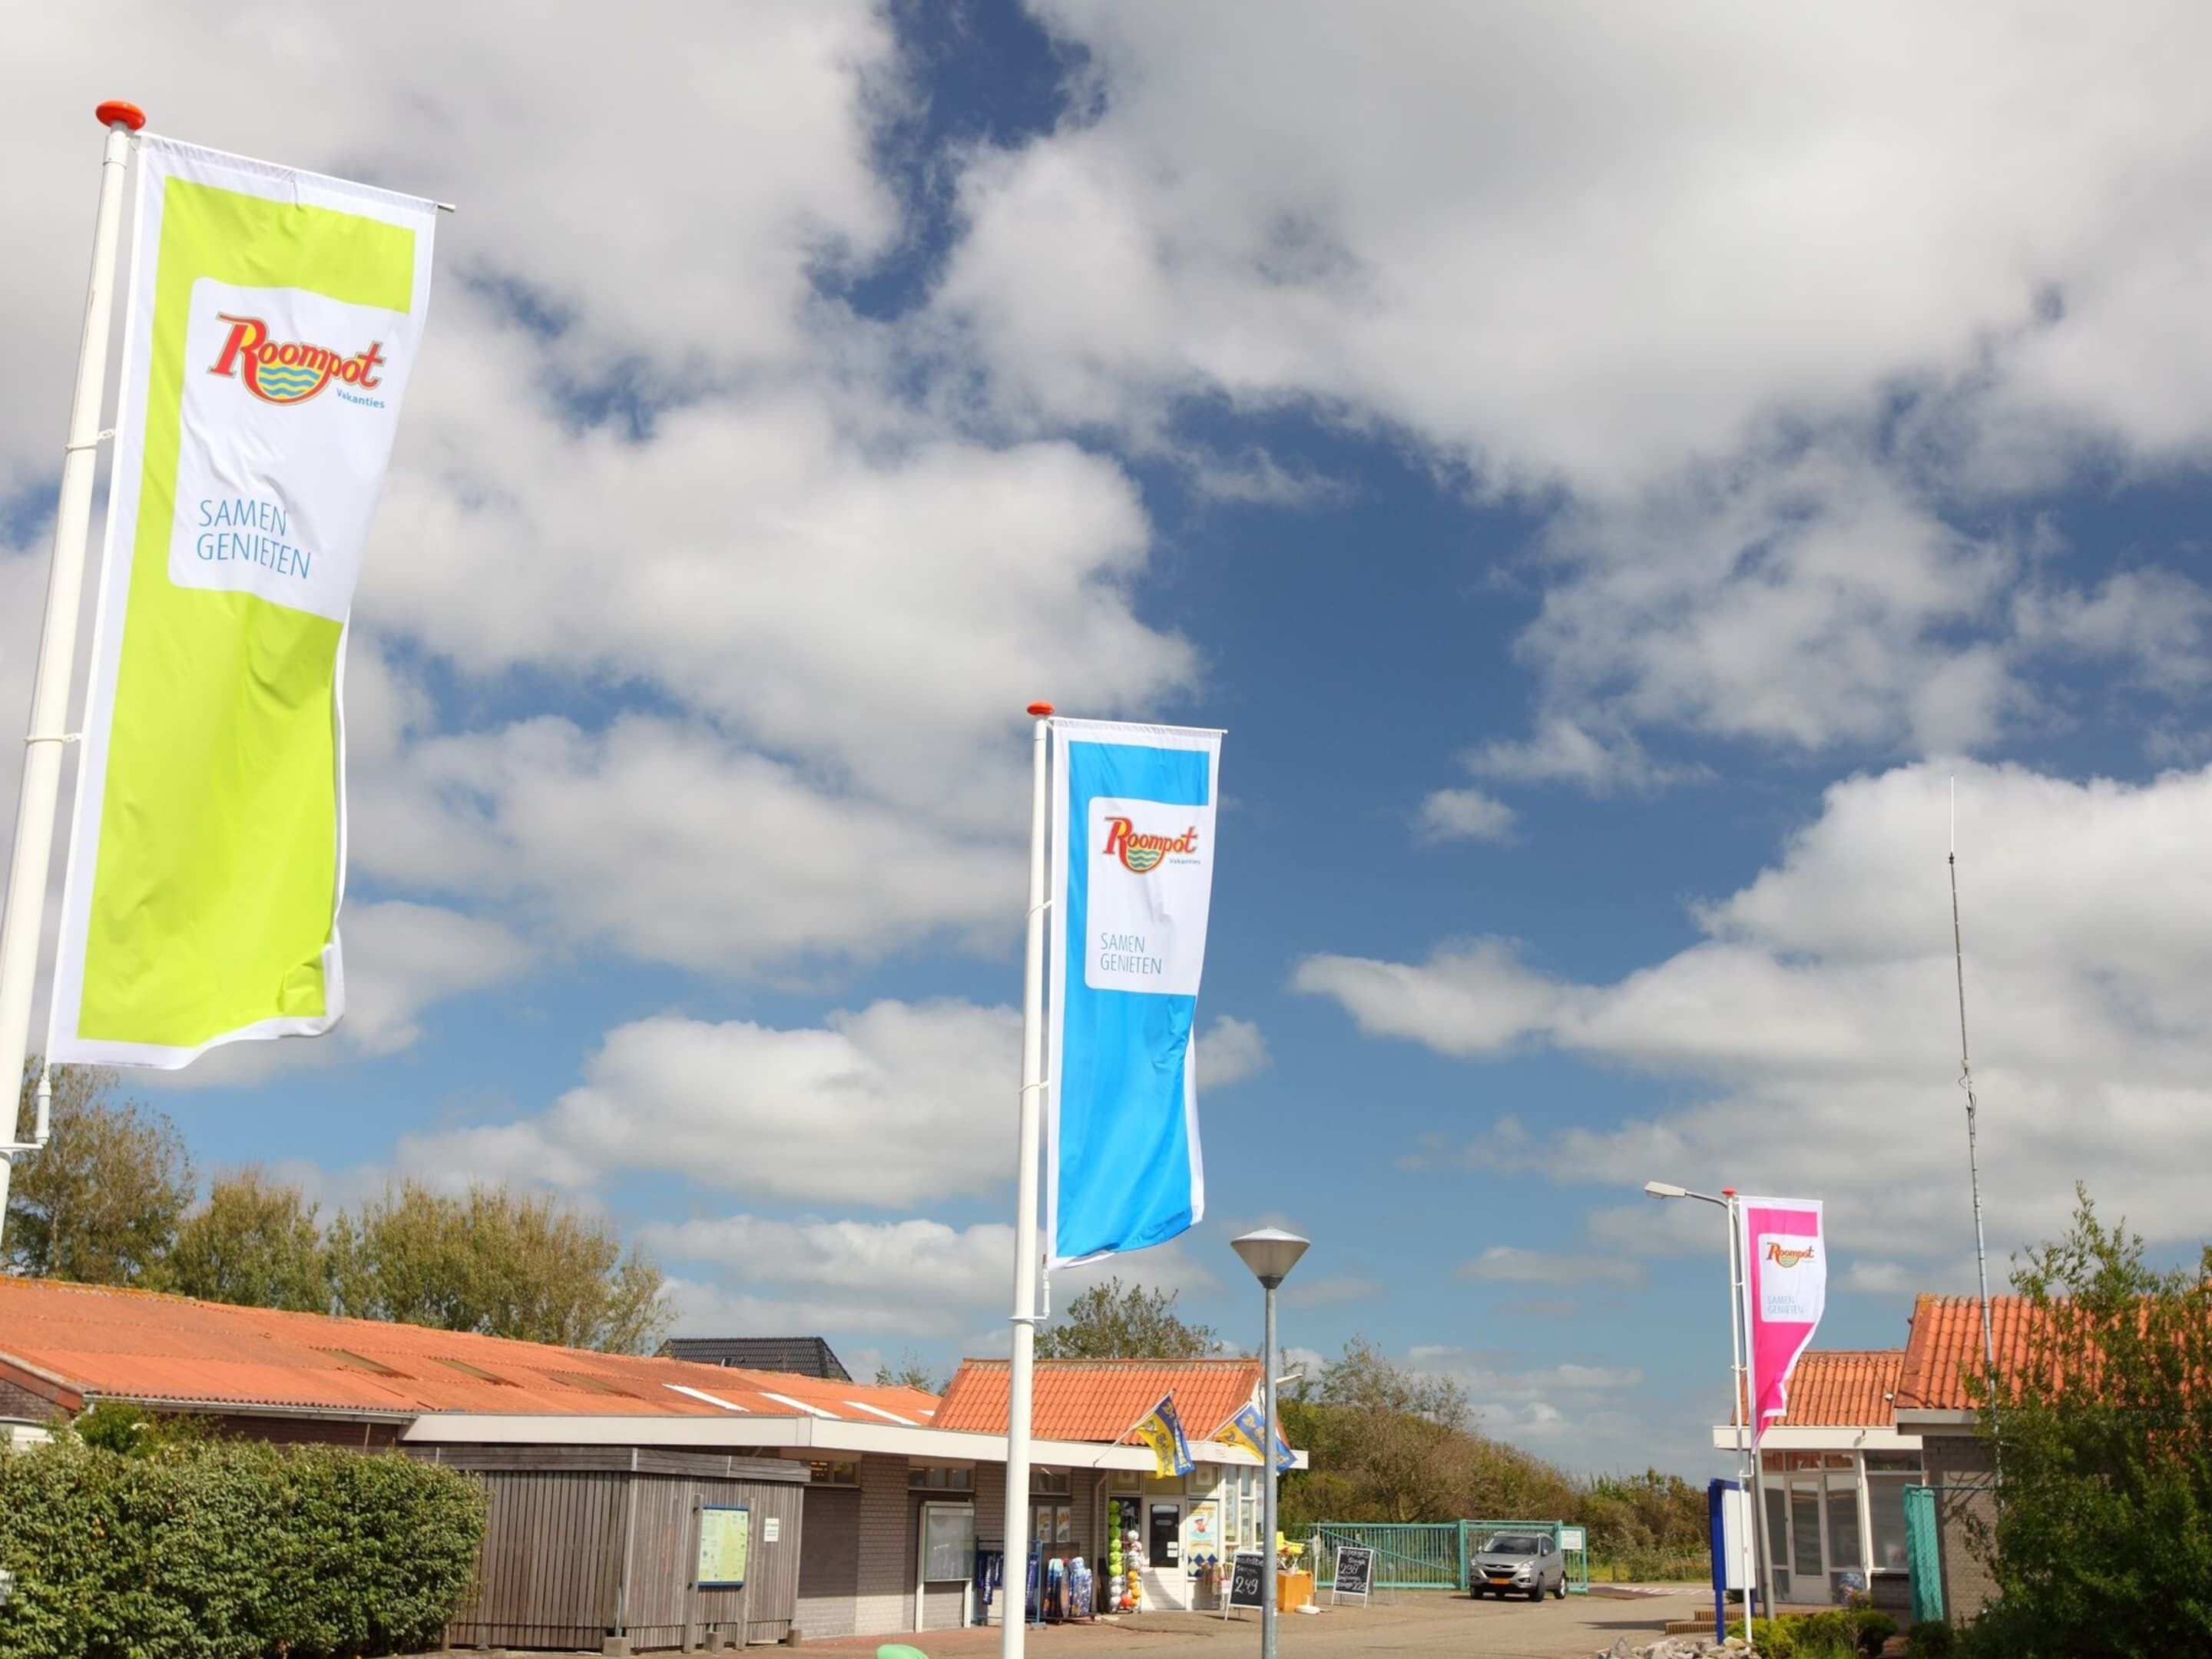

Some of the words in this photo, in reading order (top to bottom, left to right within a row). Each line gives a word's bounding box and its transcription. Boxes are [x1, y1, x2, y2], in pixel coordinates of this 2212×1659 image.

[207, 312, 386, 406] Roompot
[336, 387, 386, 409] Vakanties
[198, 498, 287, 537] SAMEN
[197, 533, 311, 580] GENIETEN
[1102, 816, 1199, 874] Roompot
[1101, 932, 1145, 953] SAMEN
[1101, 953, 1162, 975] GENIETEN
[1766, 1242, 1814, 1268] Roompot
[1767, 1296, 1795, 1305] SAMEN
